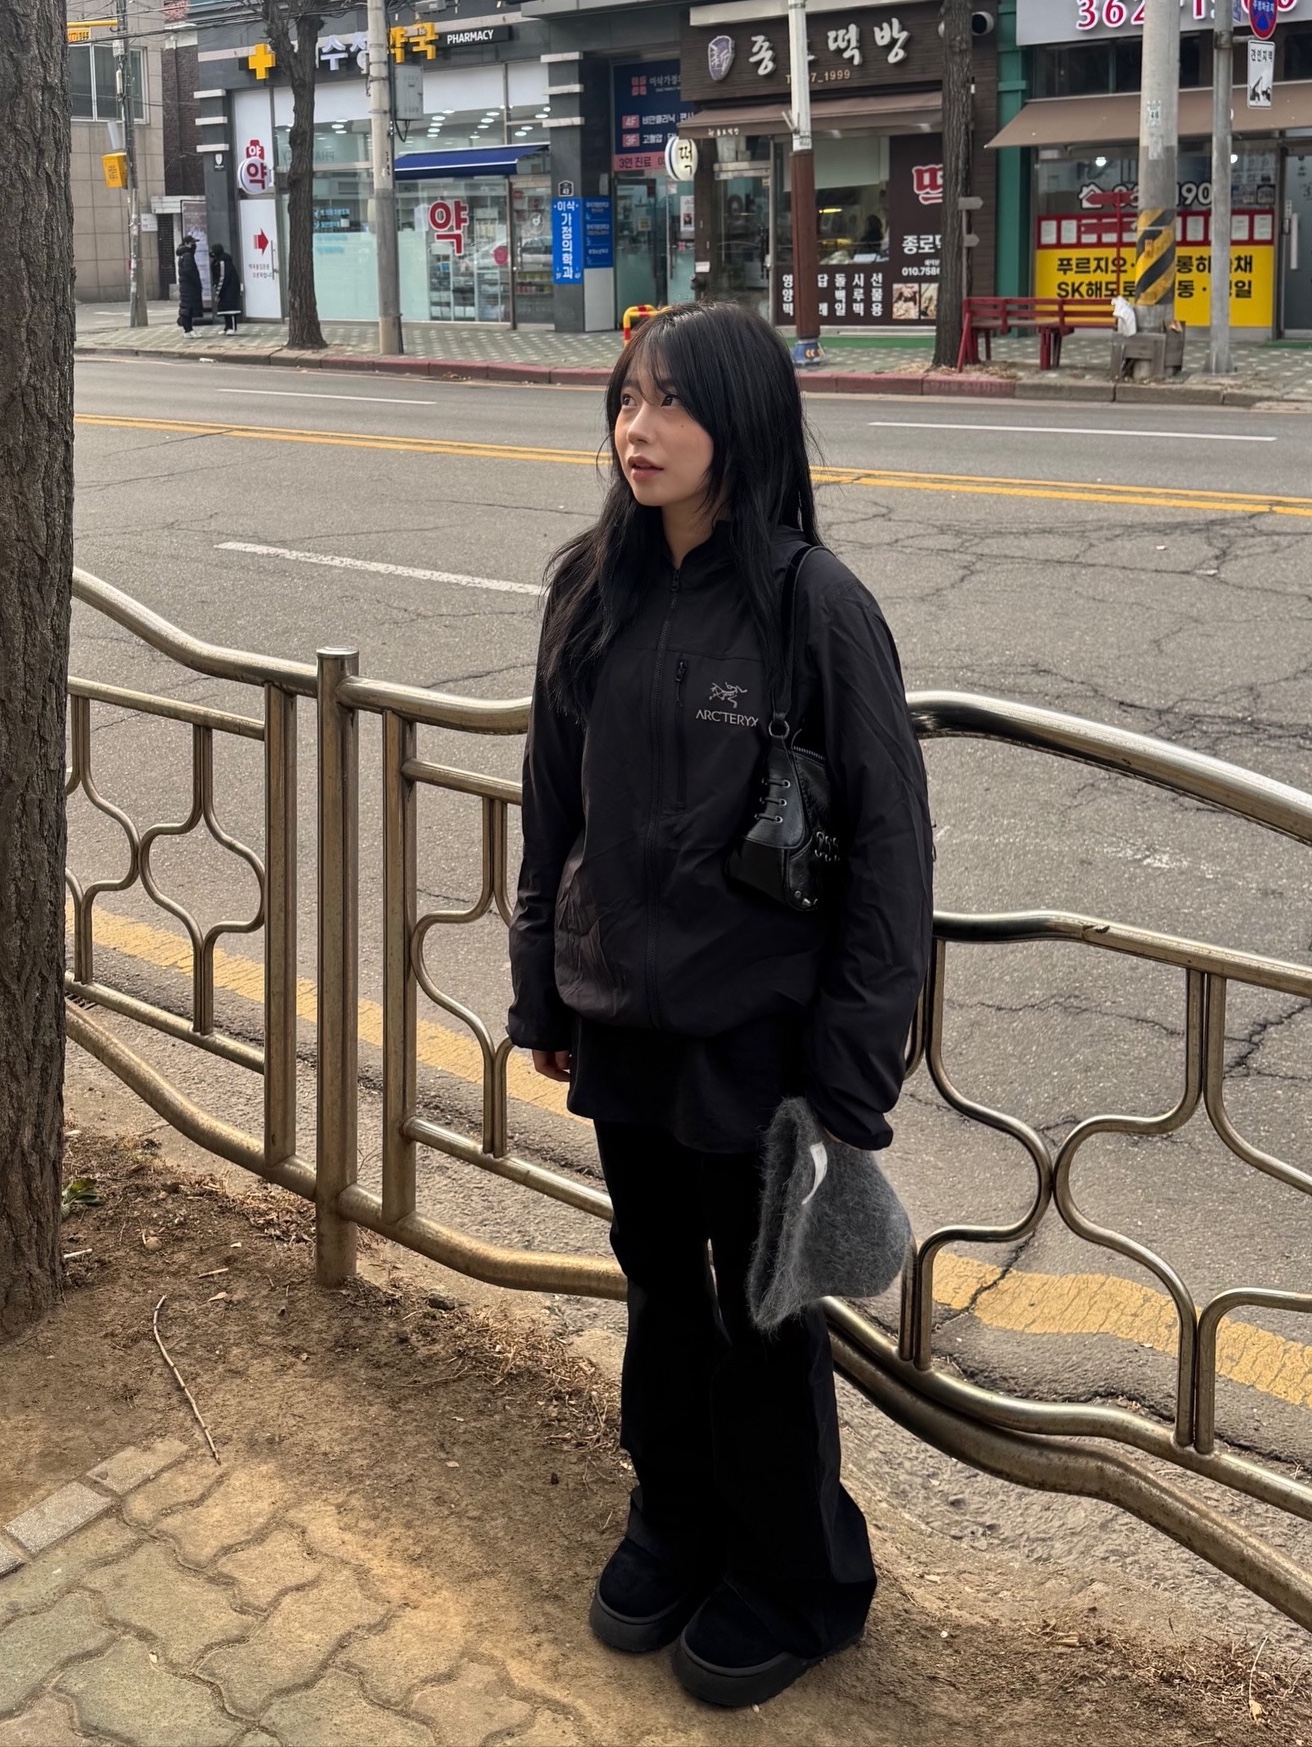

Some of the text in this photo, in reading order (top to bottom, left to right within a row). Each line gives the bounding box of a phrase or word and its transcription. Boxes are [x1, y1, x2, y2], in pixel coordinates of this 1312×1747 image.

[447, 29, 494, 45] PHARMACY
[749, 18, 911, 76] 종떡방
[246, 162, 268, 190] 약
[557, 201, 575, 211] 이삭
[429, 200, 469, 256] 약
[561, 213, 573, 279] 가정의학과
